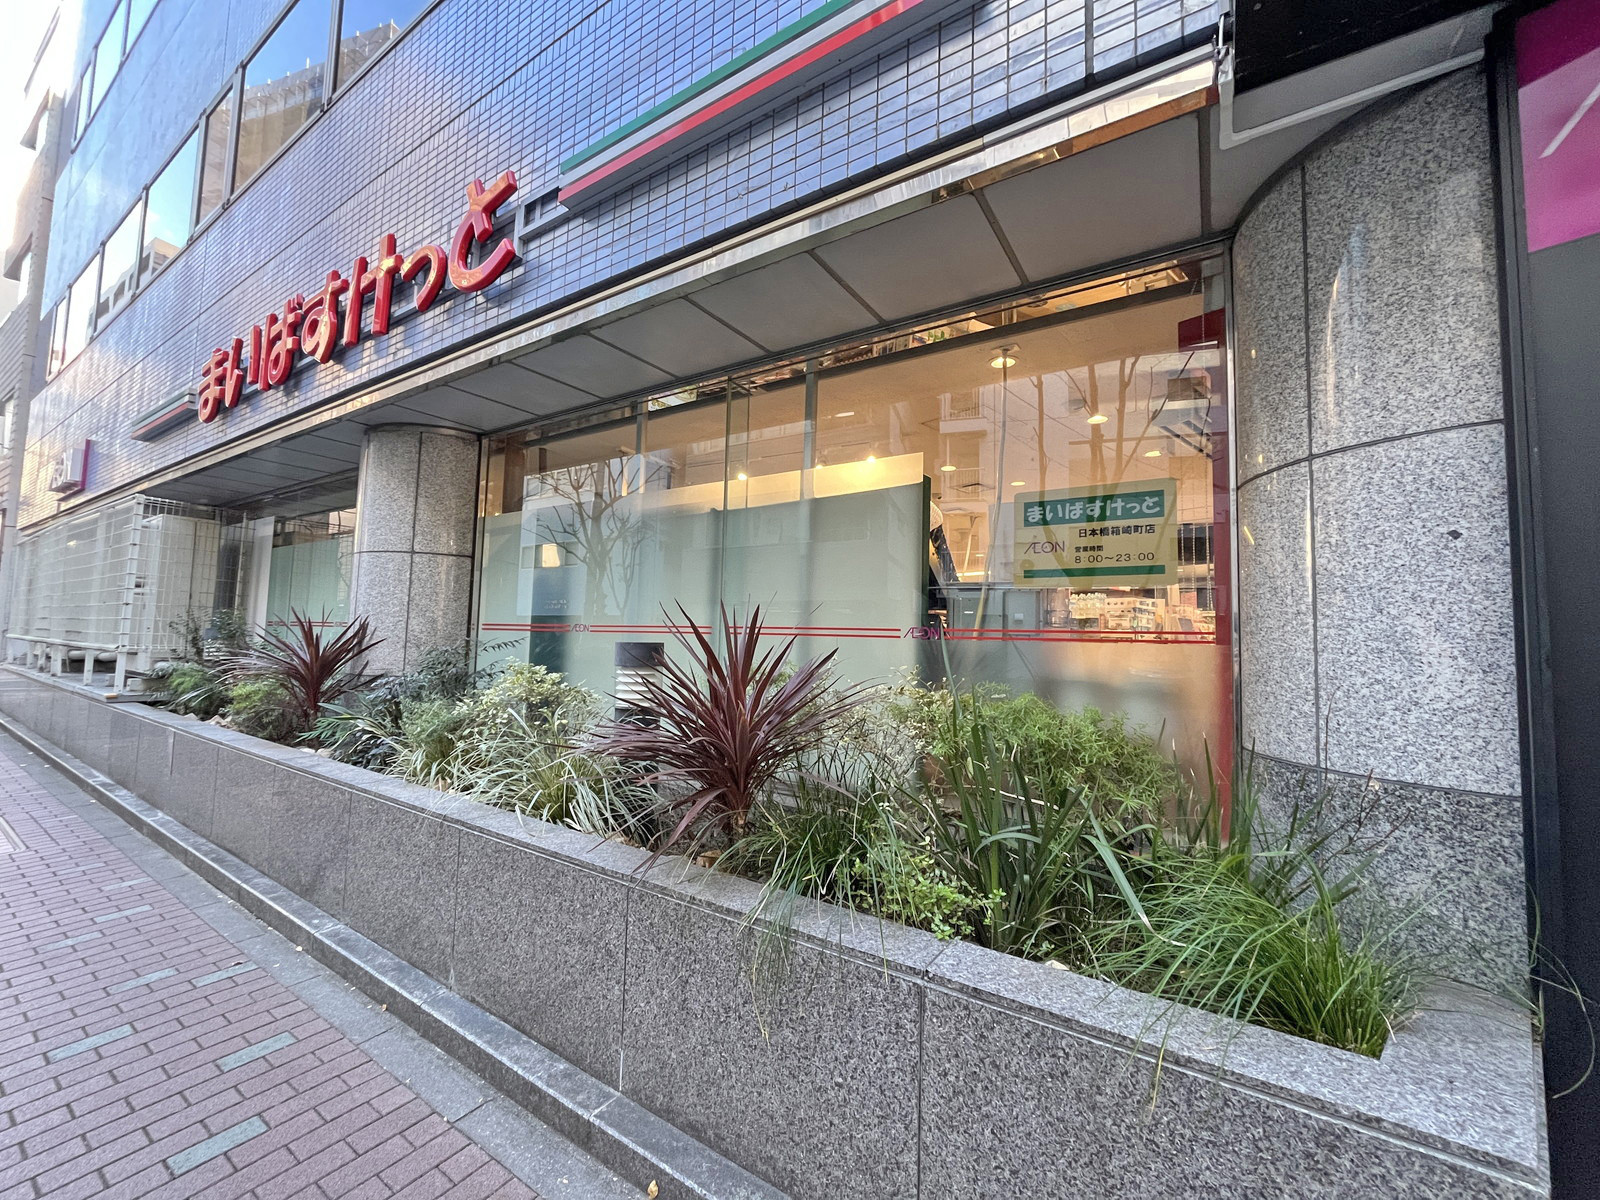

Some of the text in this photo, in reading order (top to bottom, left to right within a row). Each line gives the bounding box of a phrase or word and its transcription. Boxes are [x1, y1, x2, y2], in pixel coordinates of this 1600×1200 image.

[198, 170, 518, 424] まいばすけっと
[1026, 496, 1161, 523] まいばすけっと
[1078, 524, 1156, 538] 日本橋箱崎町店
[1074, 545, 1104, 553] 営業時間
